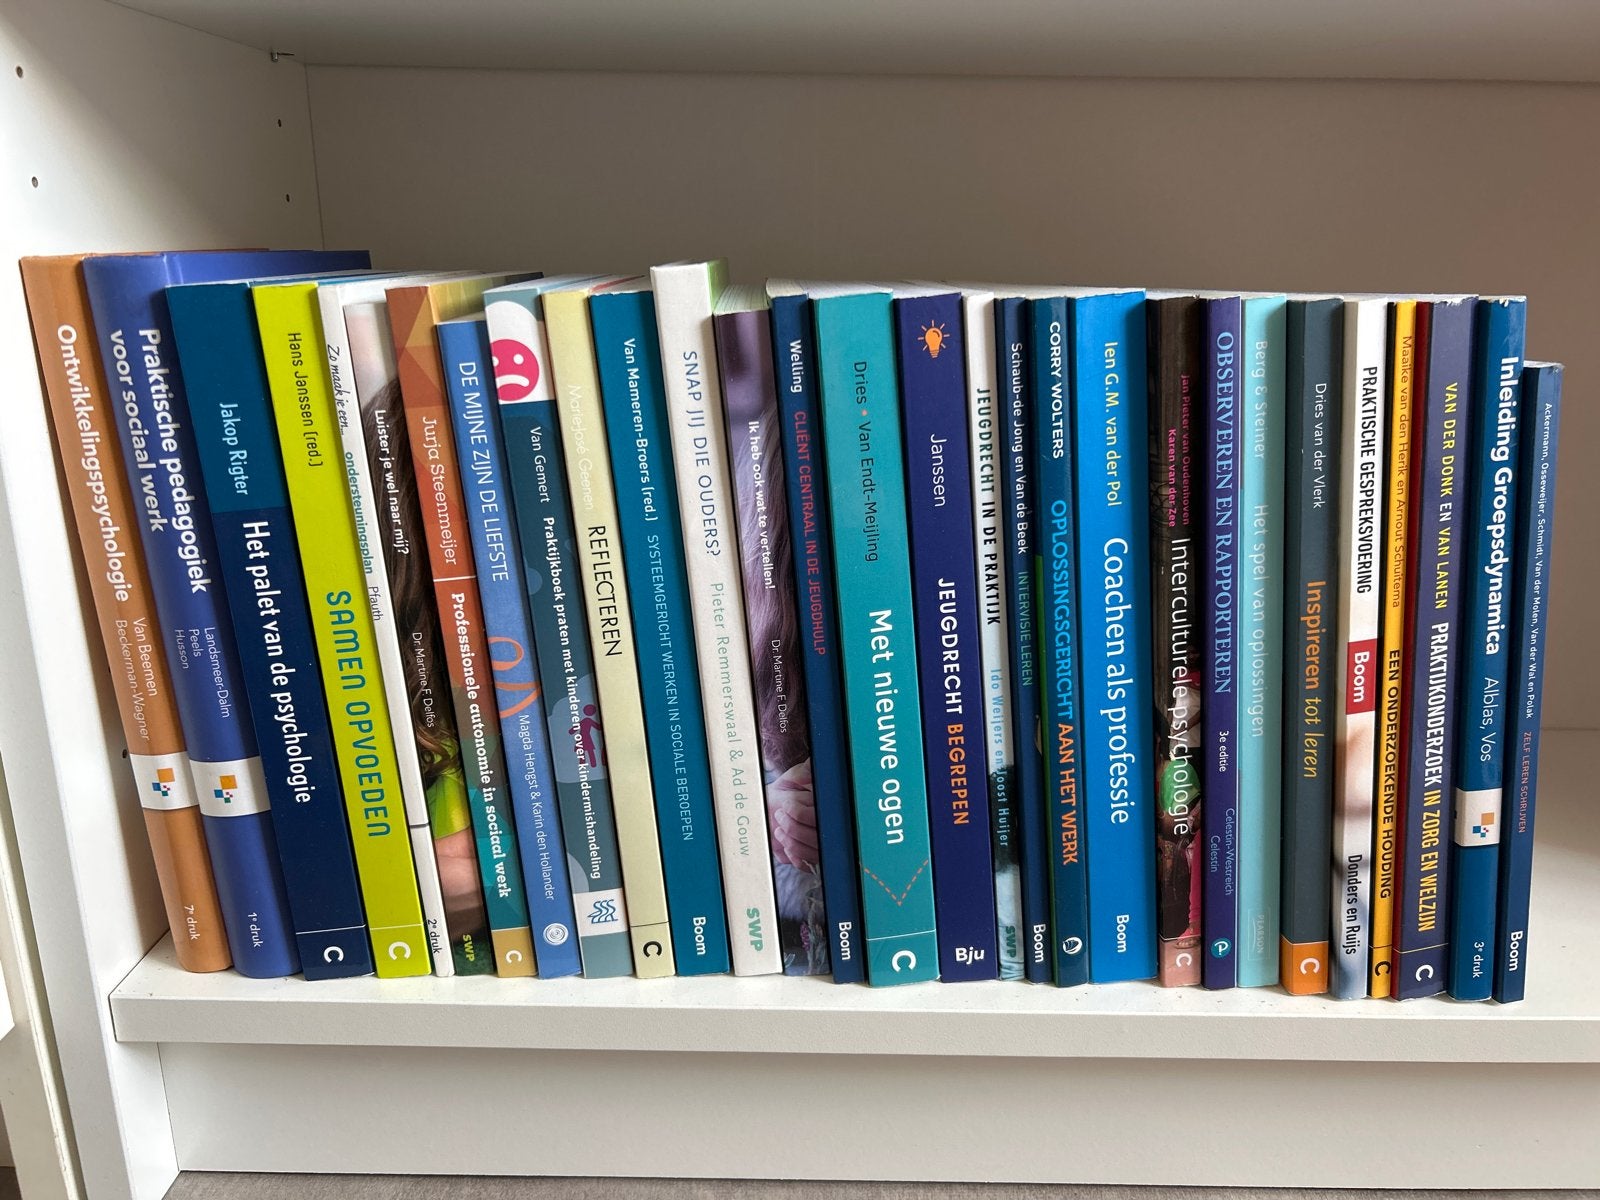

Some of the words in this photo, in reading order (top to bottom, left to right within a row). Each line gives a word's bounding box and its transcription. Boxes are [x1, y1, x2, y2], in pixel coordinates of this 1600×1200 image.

[287, 332, 302, 367] Hans
[623, 338, 635, 364] Van
[789, 340, 803, 393] Welling
[1049, 321, 1061, 378] CORRY
[139, 329, 178, 452] Praktische
[459, 361, 478, 387] DE
[683, 351, 701, 401] SNAP
[853, 361, 868, 405] Dries
[1011, 343, 1022, 417] Schaub-de
[294, 371, 313, 427] Janssen
[463, 392, 487, 445] MIJNE
[686, 409, 705, 428] JIJ
[1051, 382, 1063, 459] WOLTERS
[1216, 332, 1233, 489] OBSERVEREN
[1360, 366, 1377, 457] PRAKTISCHE
[1490, 357, 1518, 462] Inleiding
[110, 330, 132, 386] voor
[122, 391, 155, 469] sociaal
[141, 475, 167, 532] werk
[218, 403, 241, 446] Jakop
[422, 416, 440, 460] Jurja
[530, 426, 541, 451] Van
[627, 368, 649, 483] Mameren-Broers
[794, 411, 809, 461] CLIËNT
[858, 421, 871, 452] Van
[975, 388, 994, 492] JEUGDRECHT
[1011, 420, 1023, 453] Jong
[54, 325, 130, 600] Ontwikkelingspsychologie
[227, 449, 250, 495] Rigter
[471, 449, 493, 484] ZIJN
[693, 436, 709, 467] DIE
[930, 434, 946, 507] Janssen
[1014, 456, 1023, 473] en
[479, 489, 498, 514] DE
[534, 454, 549, 503] Gemert
[799, 465, 814, 537] CENTRAAL
[1015, 475, 1025, 500] Van
[158, 458, 209, 592] pedagogiek
[343, 450, 376, 575] ondersteuningsplan
[430, 464, 456, 564] Steenmeijer
[698, 475, 720, 556] OUDERS?
[861, 458, 879, 562] Endt-Meijling
[982, 501, 996, 518] IN
[1016, 502, 1026, 519] de
[1215, 495, 1232, 526] EN
[1357, 461, 1374, 594] GESPREKSVOERING
[243, 521, 269, 559] Het
[484, 518, 508, 581] LIEFSTE
[805, 540, 816, 555] IN
[983, 526, 996, 545] DE
[1016, 522, 1027, 555] Beek
[543, 517, 564, 601] Praktijkboek
[806, 557, 818, 576] DE
[1485, 467, 1511, 654] Groepsdynamica
[1534, 560, 1542, 578] Van
[246, 565, 280, 616] palet
[366, 584, 384, 622] Pfauth
[588, 526, 621, 656] REFLECTEREN
[647, 535, 671, 647] SYSTEEMGERICHT
[983, 552, 1000, 624] PRAKTIJK
[1017, 571, 1029, 642] INTERVISIE
[1051, 500, 1072, 718] OPLOSSINGSGERICHT
[1104, 538, 1130, 657] Coachen
[1533, 579, 1541, 595] der
[133, 617, 146, 642] Van
[553, 604, 568, 646] praten
[808, 579, 825, 655] JEUGDHULP
[869, 609, 893, 663] Met
[1171, 538, 1191, 699] Interculturele
[1215, 533, 1231, 693] RAPPORTEREN
[1301, 581, 1325, 689] Inspireren
[1530, 627, 1538, 645] Van
[174, 629, 188, 669] Husson
[188, 628, 203, 657] Peels
[263, 620, 283, 657] van
[451, 593, 479, 699] Professionele
[562, 648, 574, 673] met
[938, 579, 961, 713] JEUGDRECHT
[1529, 646, 1537, 662] der
[115, 620, 149, 740] Beckerman-Wagner
[138, 644, 157, 696] Beemen
[204, 627, 230, 718] Landsmeer-Dalm
[270, 662, 295, 686] de
[662, 651, 677, 705] WERKEN
[1020, 645, 1032, 686] LEREN
[1106, 663, 1132, 700] als
[1353, 651, 1369, 702] Boom
[1388, 649, 1400, 681] EEN
[1527, 681, 1533, 693] en
[1528, 662, 1536, 680] Wal
[566, 675, 583, 732] kinderen
[668, 708, 679, 721] IN
[874, 672, 898, 768] nieuwe
[1304, 696, 1321, 725] tot
[1424, 623, 1448, 786] PRAKTIJKONDERZOEK
[1480, 677, 1498, 729] Alblas,
[1526, 694, 1534, 719] Polak
[271, 692, 314, 802] psychologie
[469, 703, 492, 784] autonomie
[574, 733, 584, 760] over
[670, 724, 686, 775] SOCIALE
[1058, 723, 1074, 764] AAN
[1219, 730, 1229, 743] 3e
[1219, 745, 1228, 772] editie
[1303, 732, 1323, 778] leren
[1381, 685, 1399, 825] ONDERZOEKENDE
[1480, 732, 1496, 762] Vos
[1523, 731, 1531, 752] ZELF
[947, 724, 968, 824] BEGREPEN
[1060, 768, 1075, 807] HET
[1100, 707, 1134, 823] professie
[1168, 704, 1191, 834] psychologie
[1521, 755, 1529, 783] LEREN
[482, 787, 495, 803] in
[676, 777, 692, 841] BEROEPEN
[878, 779, 903, 844] ogen
[1423, 789, 1440, 807] IN
[1518, 785, 1528, 833] SCHRIJVEN
[485, 805, 505, 859] sociaal
[578, 762, 600, 879] kindermishandeling
[1061, 810, 1077, 865] WERK
[1421, 810, 1439, 849] ZORG
[1210, 835, 1220, 873] Celestin
[1224, 808, 1234, 896] Celestin-Westreich
[1379, 828, 1393, 900] HOUDING
[1420, 851, 1438, 872] EN
[494, 861, 511, 898] werk
[1345, 854, 1362, 905] Donders
[1418, 873, 1436, 932] WELZIJN
[692, 916, 706, 955] Boom
[746, 907, 763, 952] SWP
[1116, 914, 1129, 953] Boom
[1346, 907, 1357, 923] en
[462, 934, 474, 962] SWP
[838, 921, 851, 961] Boom
[955, 947, 984, 963] Bju
[1005, 924, 1016, 959] SWP
[1033, 924, 1045, 963] Boom
[1342, 925, 1360, 955] Ruijs
[1509, 930, 1523, 972] Boom
